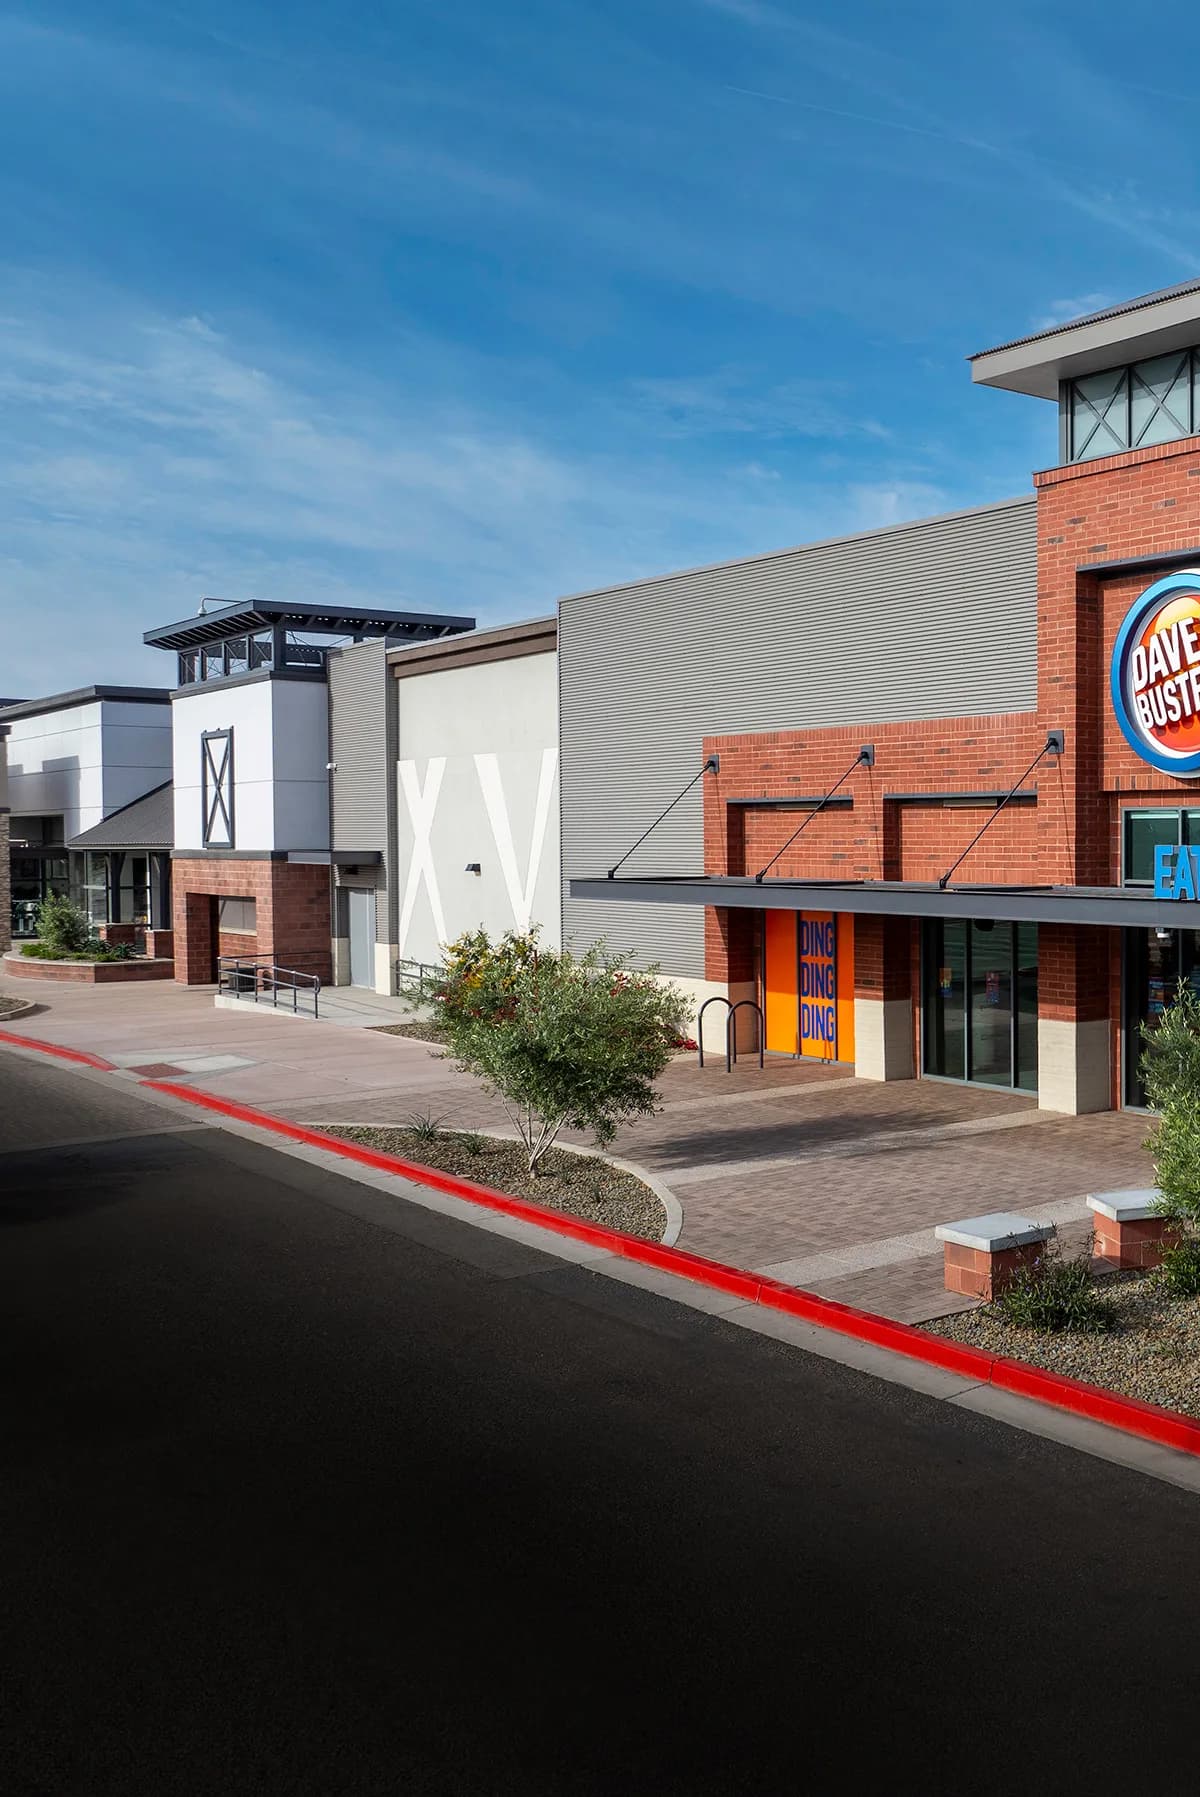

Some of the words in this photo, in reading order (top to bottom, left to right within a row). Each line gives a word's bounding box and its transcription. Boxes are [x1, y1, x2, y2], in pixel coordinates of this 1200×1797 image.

[801, 921, 834, 958] DING
[801, 962, 834, 1000] DING
[801, 1003, 834, 1042] DING
